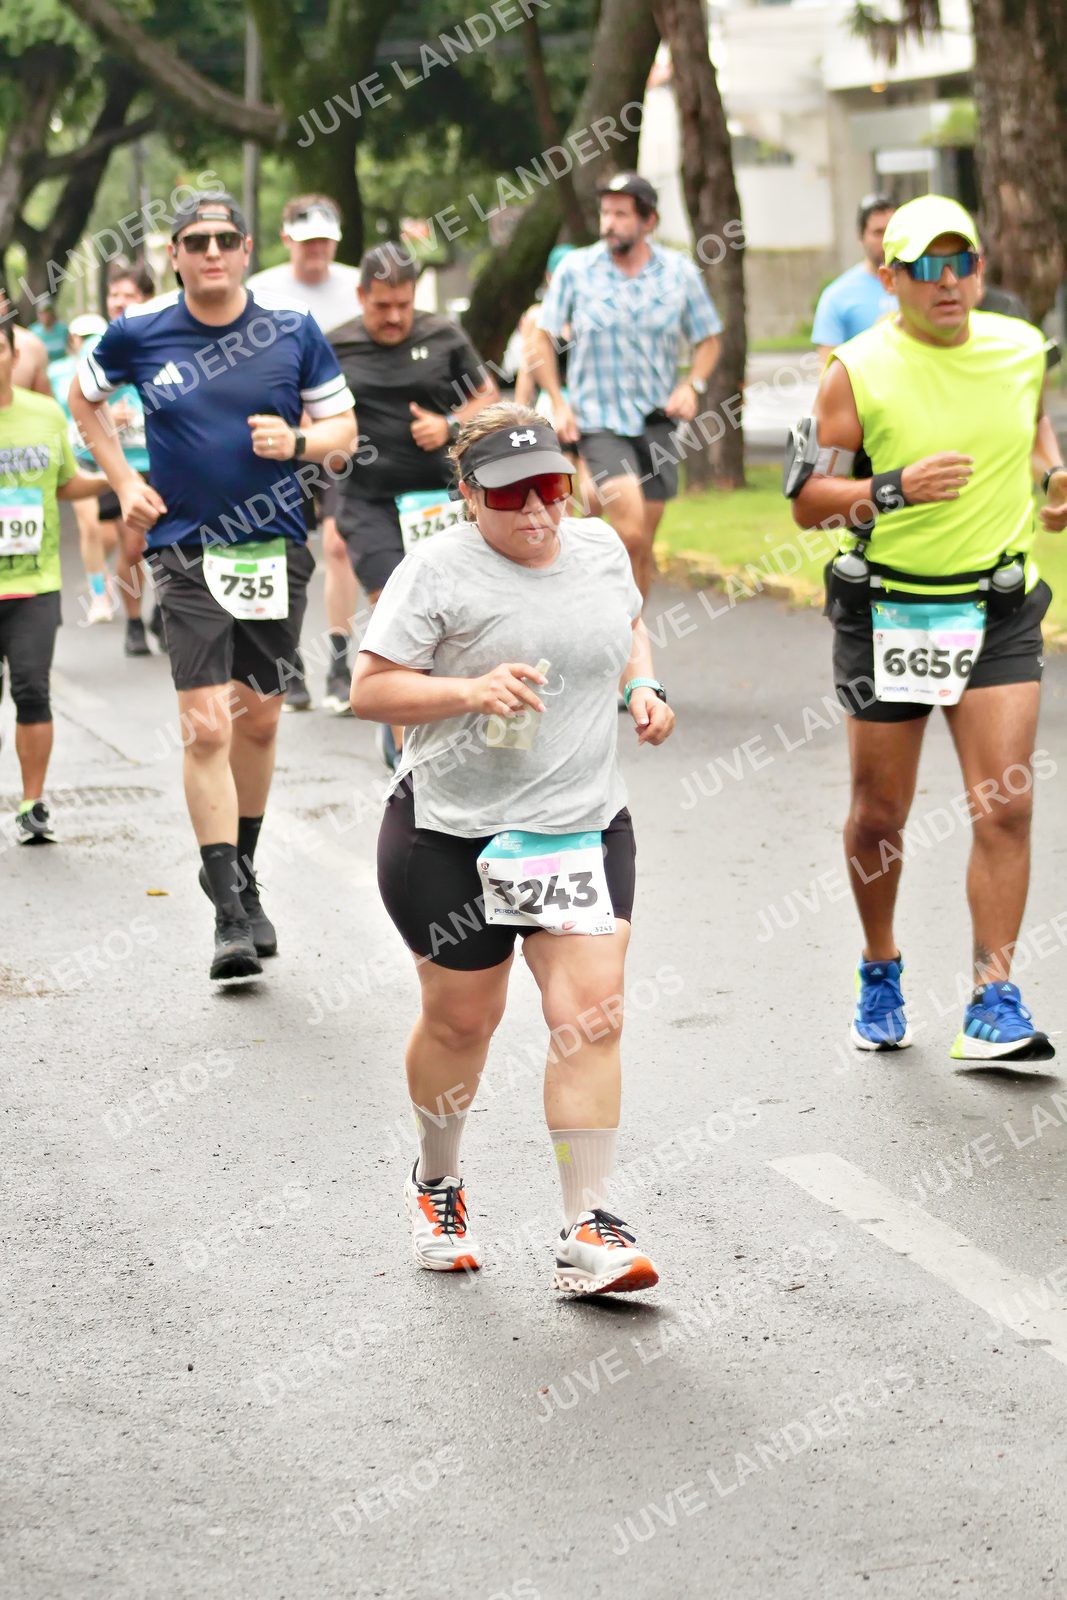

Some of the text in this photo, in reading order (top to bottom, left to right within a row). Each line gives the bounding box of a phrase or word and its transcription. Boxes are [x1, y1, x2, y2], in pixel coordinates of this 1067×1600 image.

[220, 574, 274, 600] 735
[883, 647, 974, 680] 6656
[488, 871, 598, 915] 3243
